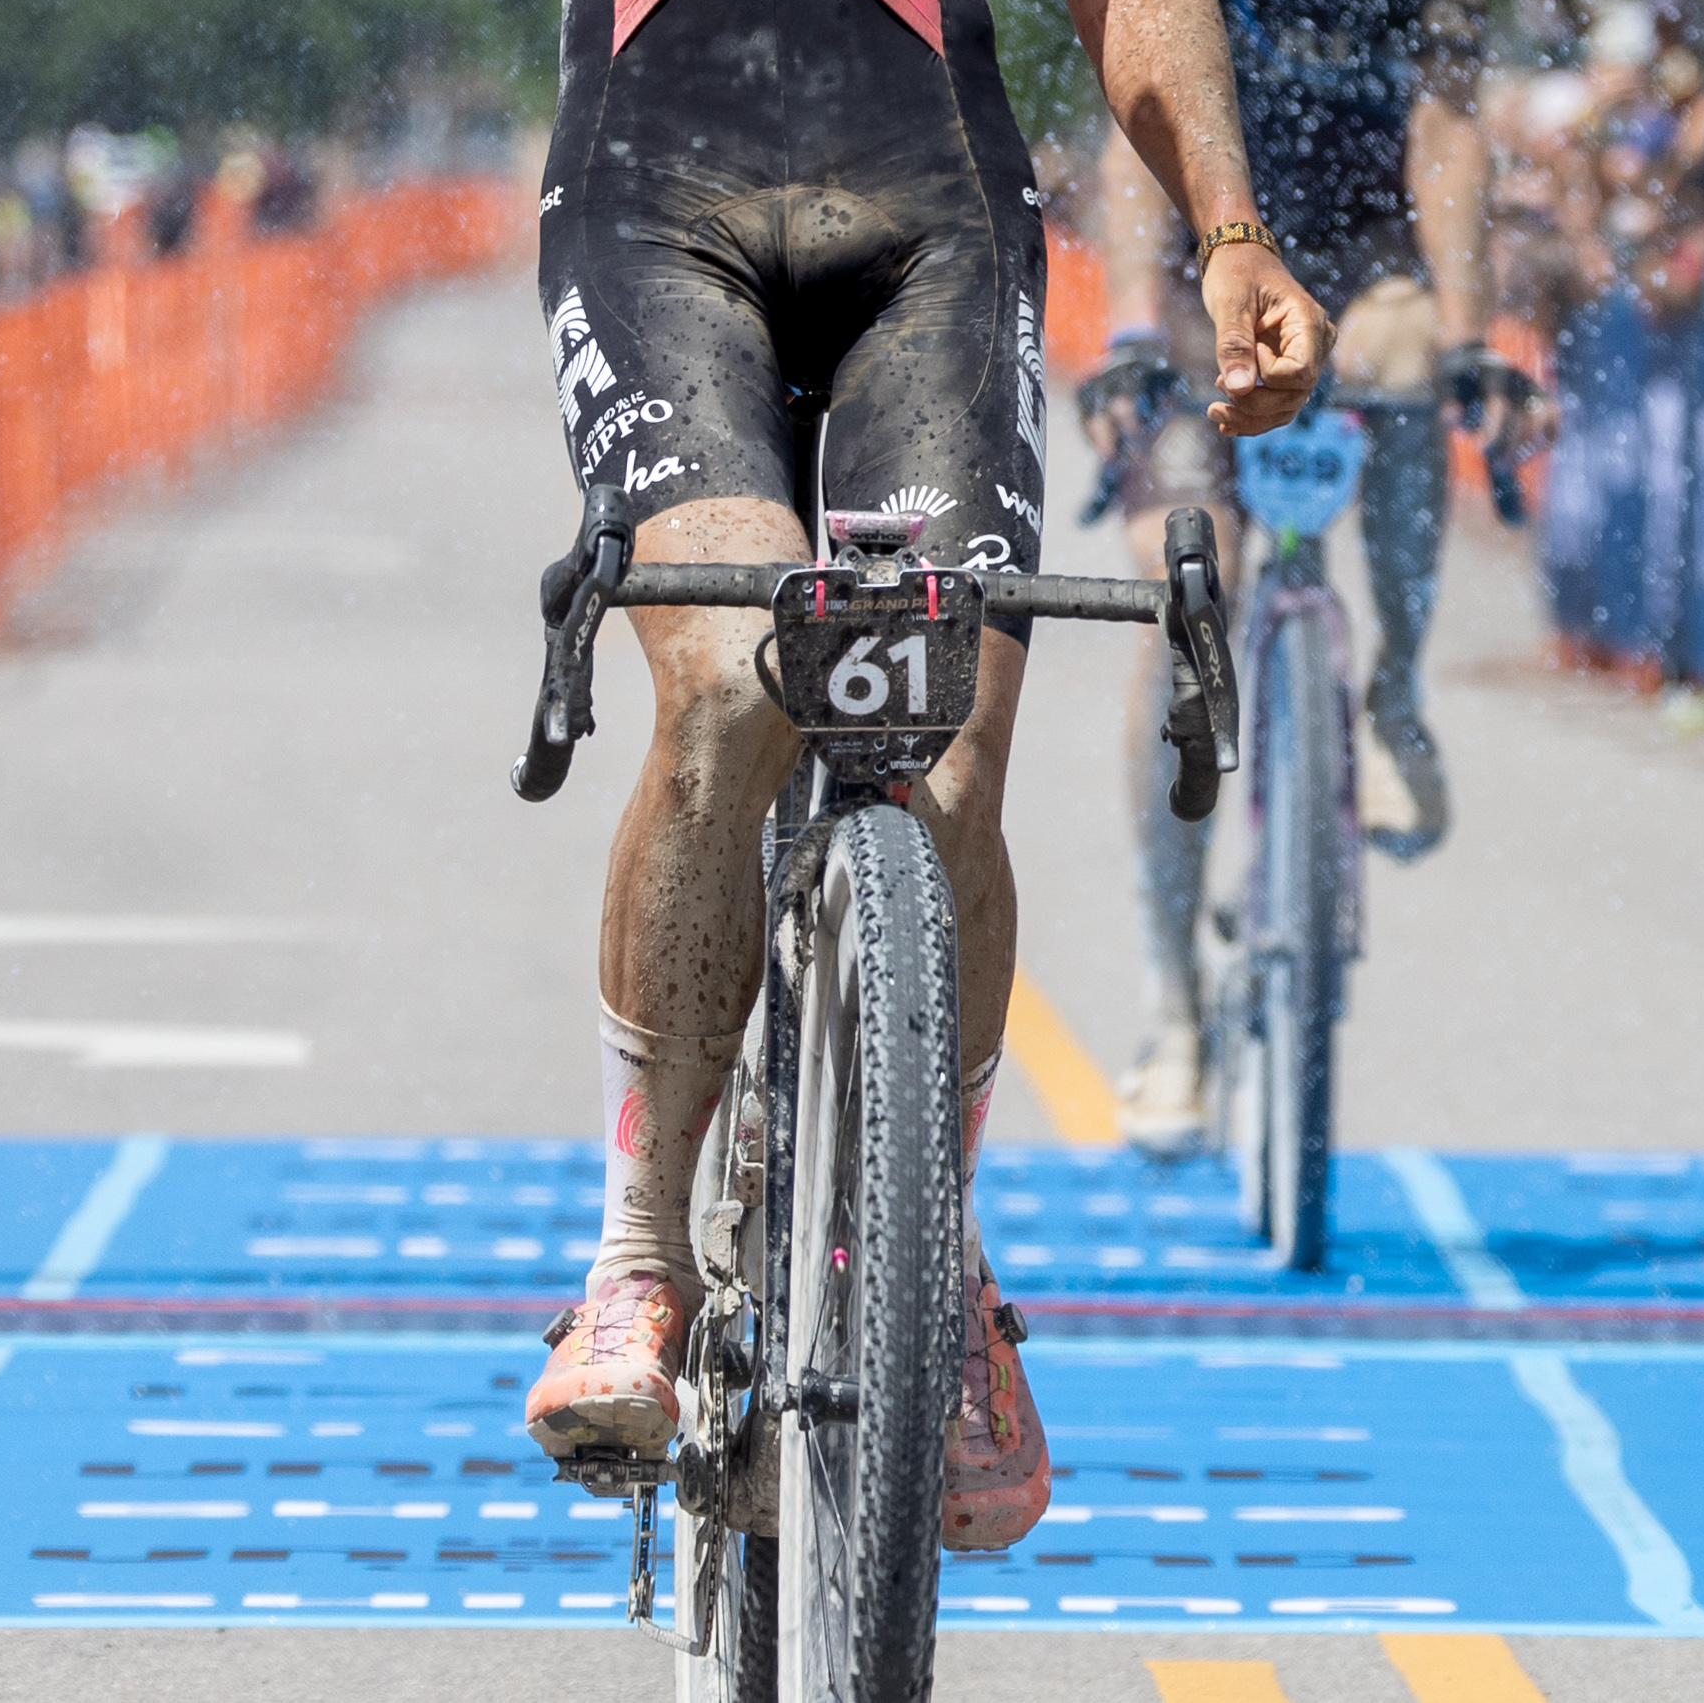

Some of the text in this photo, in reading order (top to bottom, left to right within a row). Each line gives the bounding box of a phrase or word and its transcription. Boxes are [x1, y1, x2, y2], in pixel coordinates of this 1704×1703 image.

[581, 399, 673, 490] NIPPO
[848, 530, 908, 542] wahoo
[849, 598, 908, 612] GRAND
[911, 597, 948, 610] PRX
[828, 634, 928, 716] 61
[1199, 620, 1225, 689] GRX
